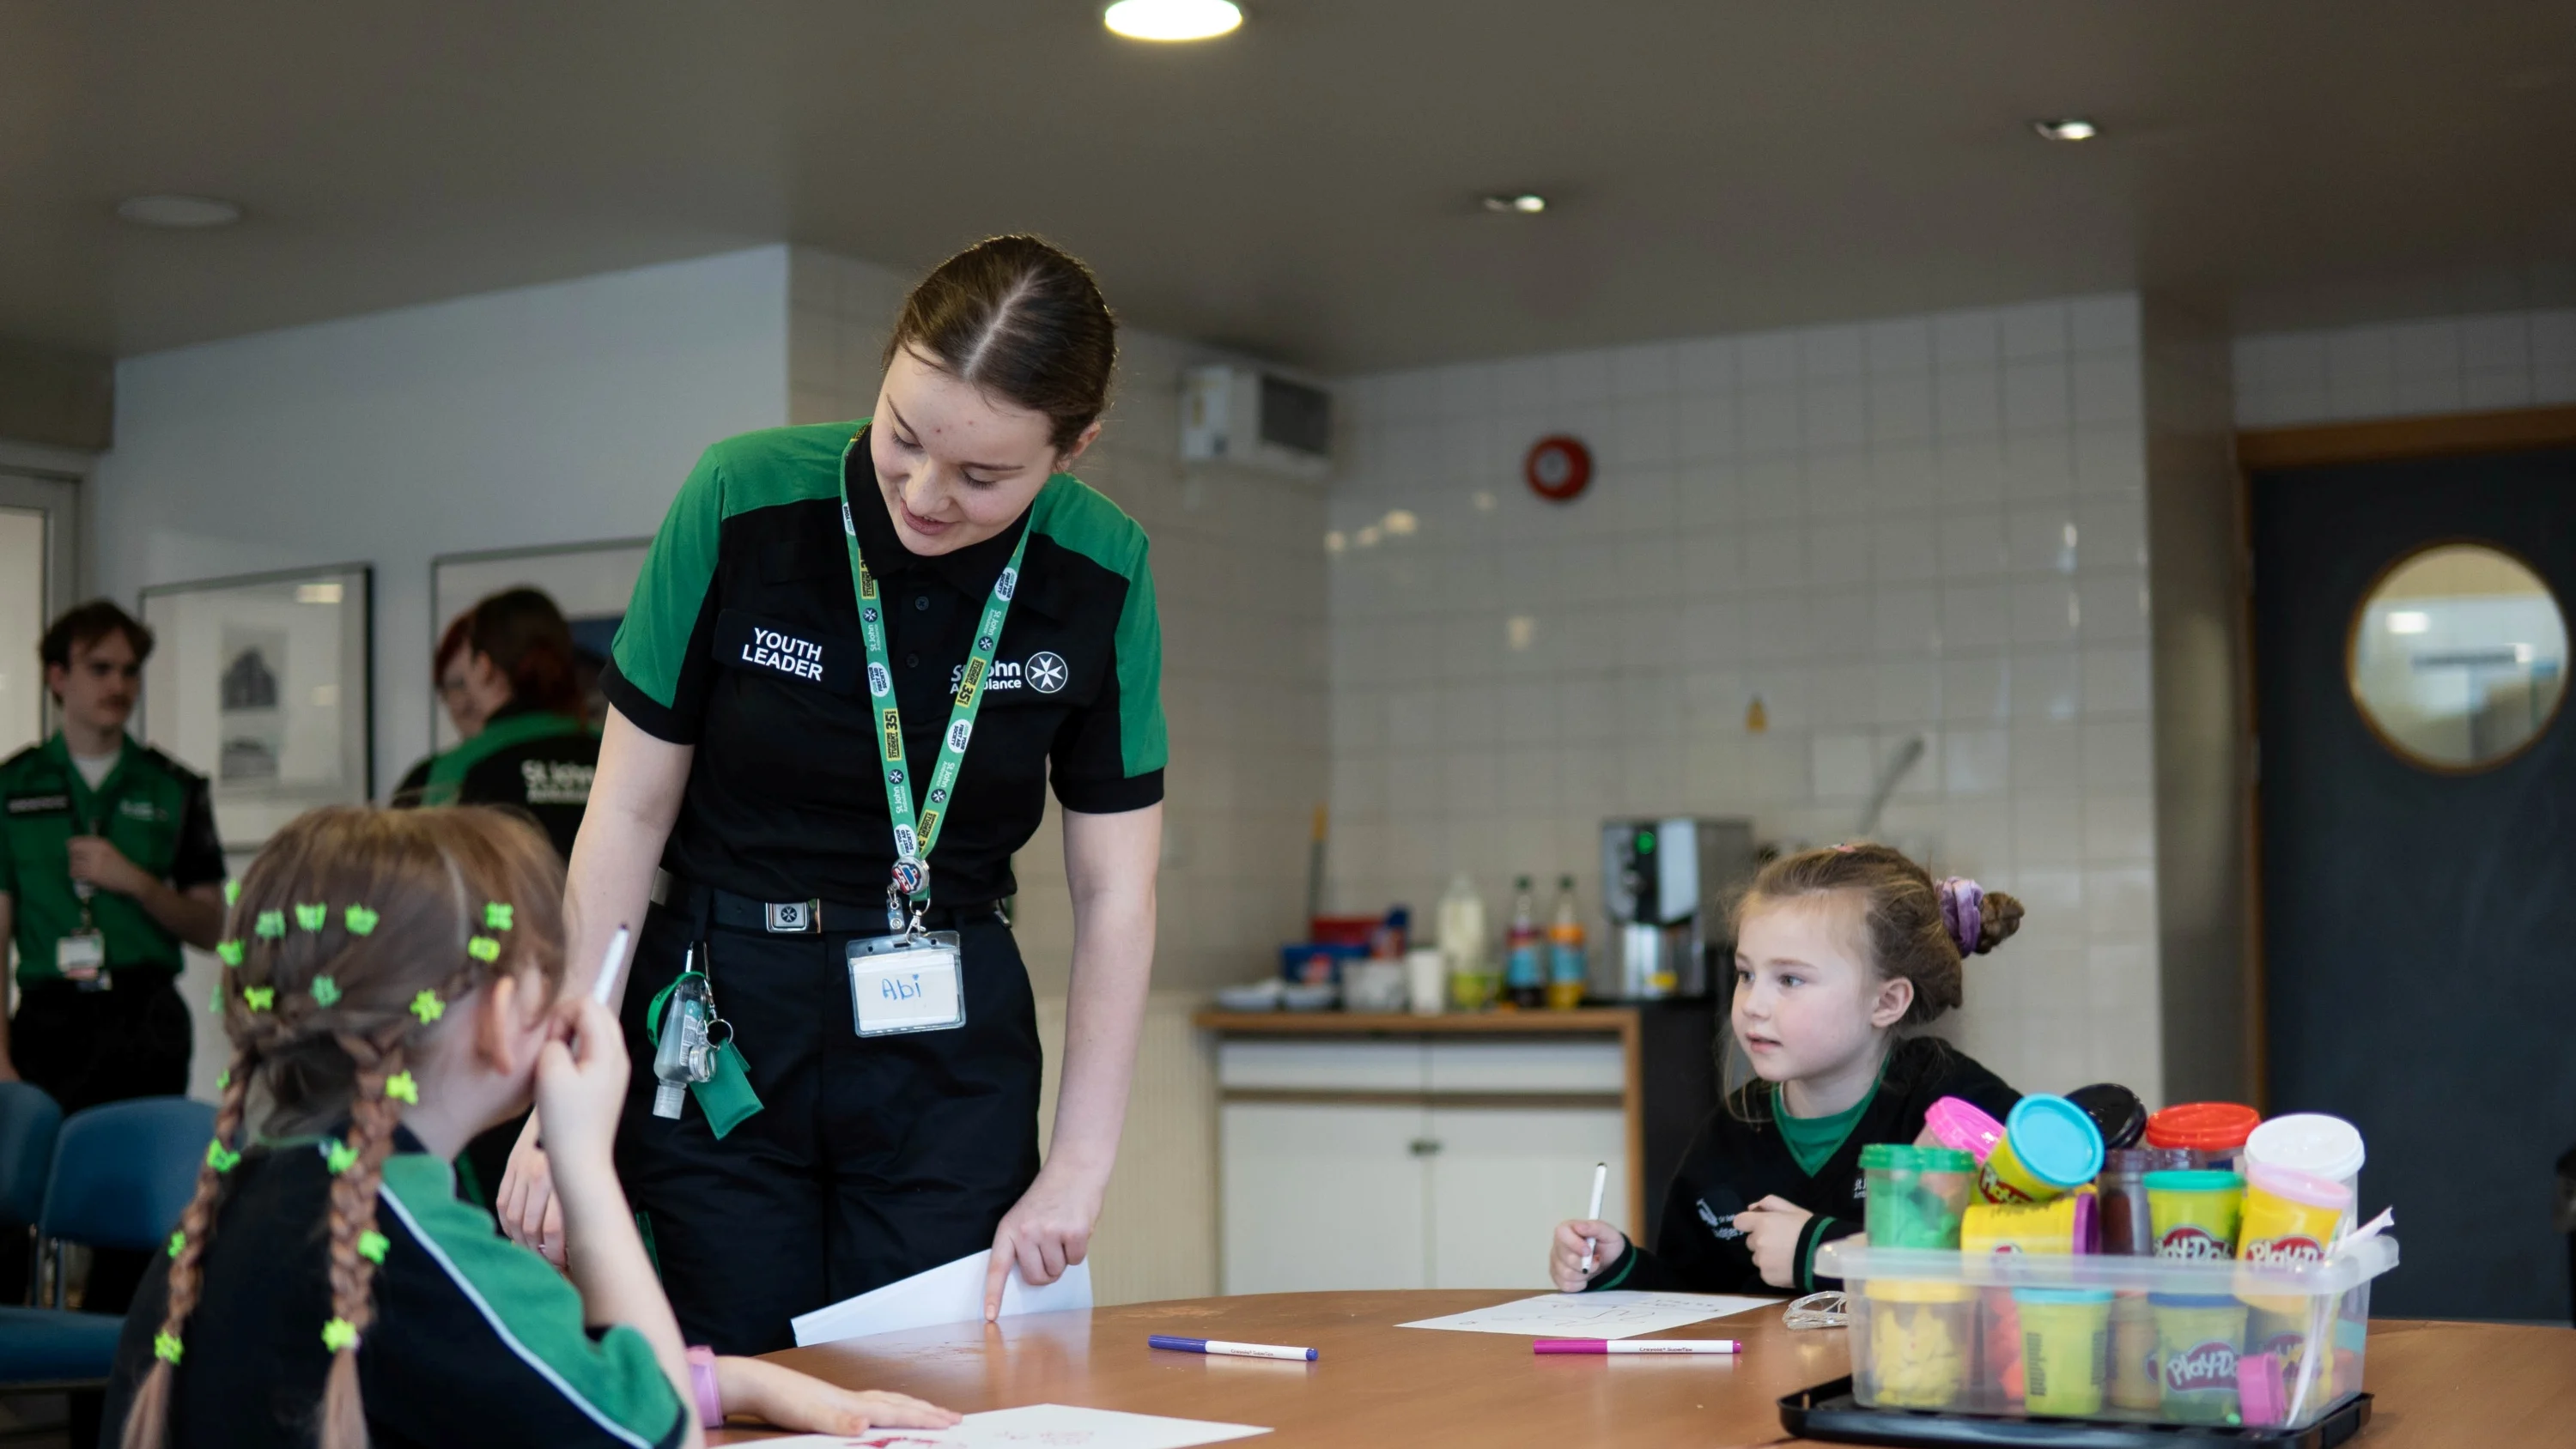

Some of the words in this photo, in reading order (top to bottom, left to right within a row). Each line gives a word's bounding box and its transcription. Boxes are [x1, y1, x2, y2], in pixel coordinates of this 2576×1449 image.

[988, 618, 999, 635] John
[754, 627, 823, 662] YOUTH
[741, 644, 823, 682] LEADER
[959, 684, 974, 702] 35
[885, 714, 898, 731] 35
[940, 769, 952, 788] John
[893, 786, 902, 804] John
[881, 973, 921, 1000] Abi
[2167, 1351, 2238, 1385] Play-D
